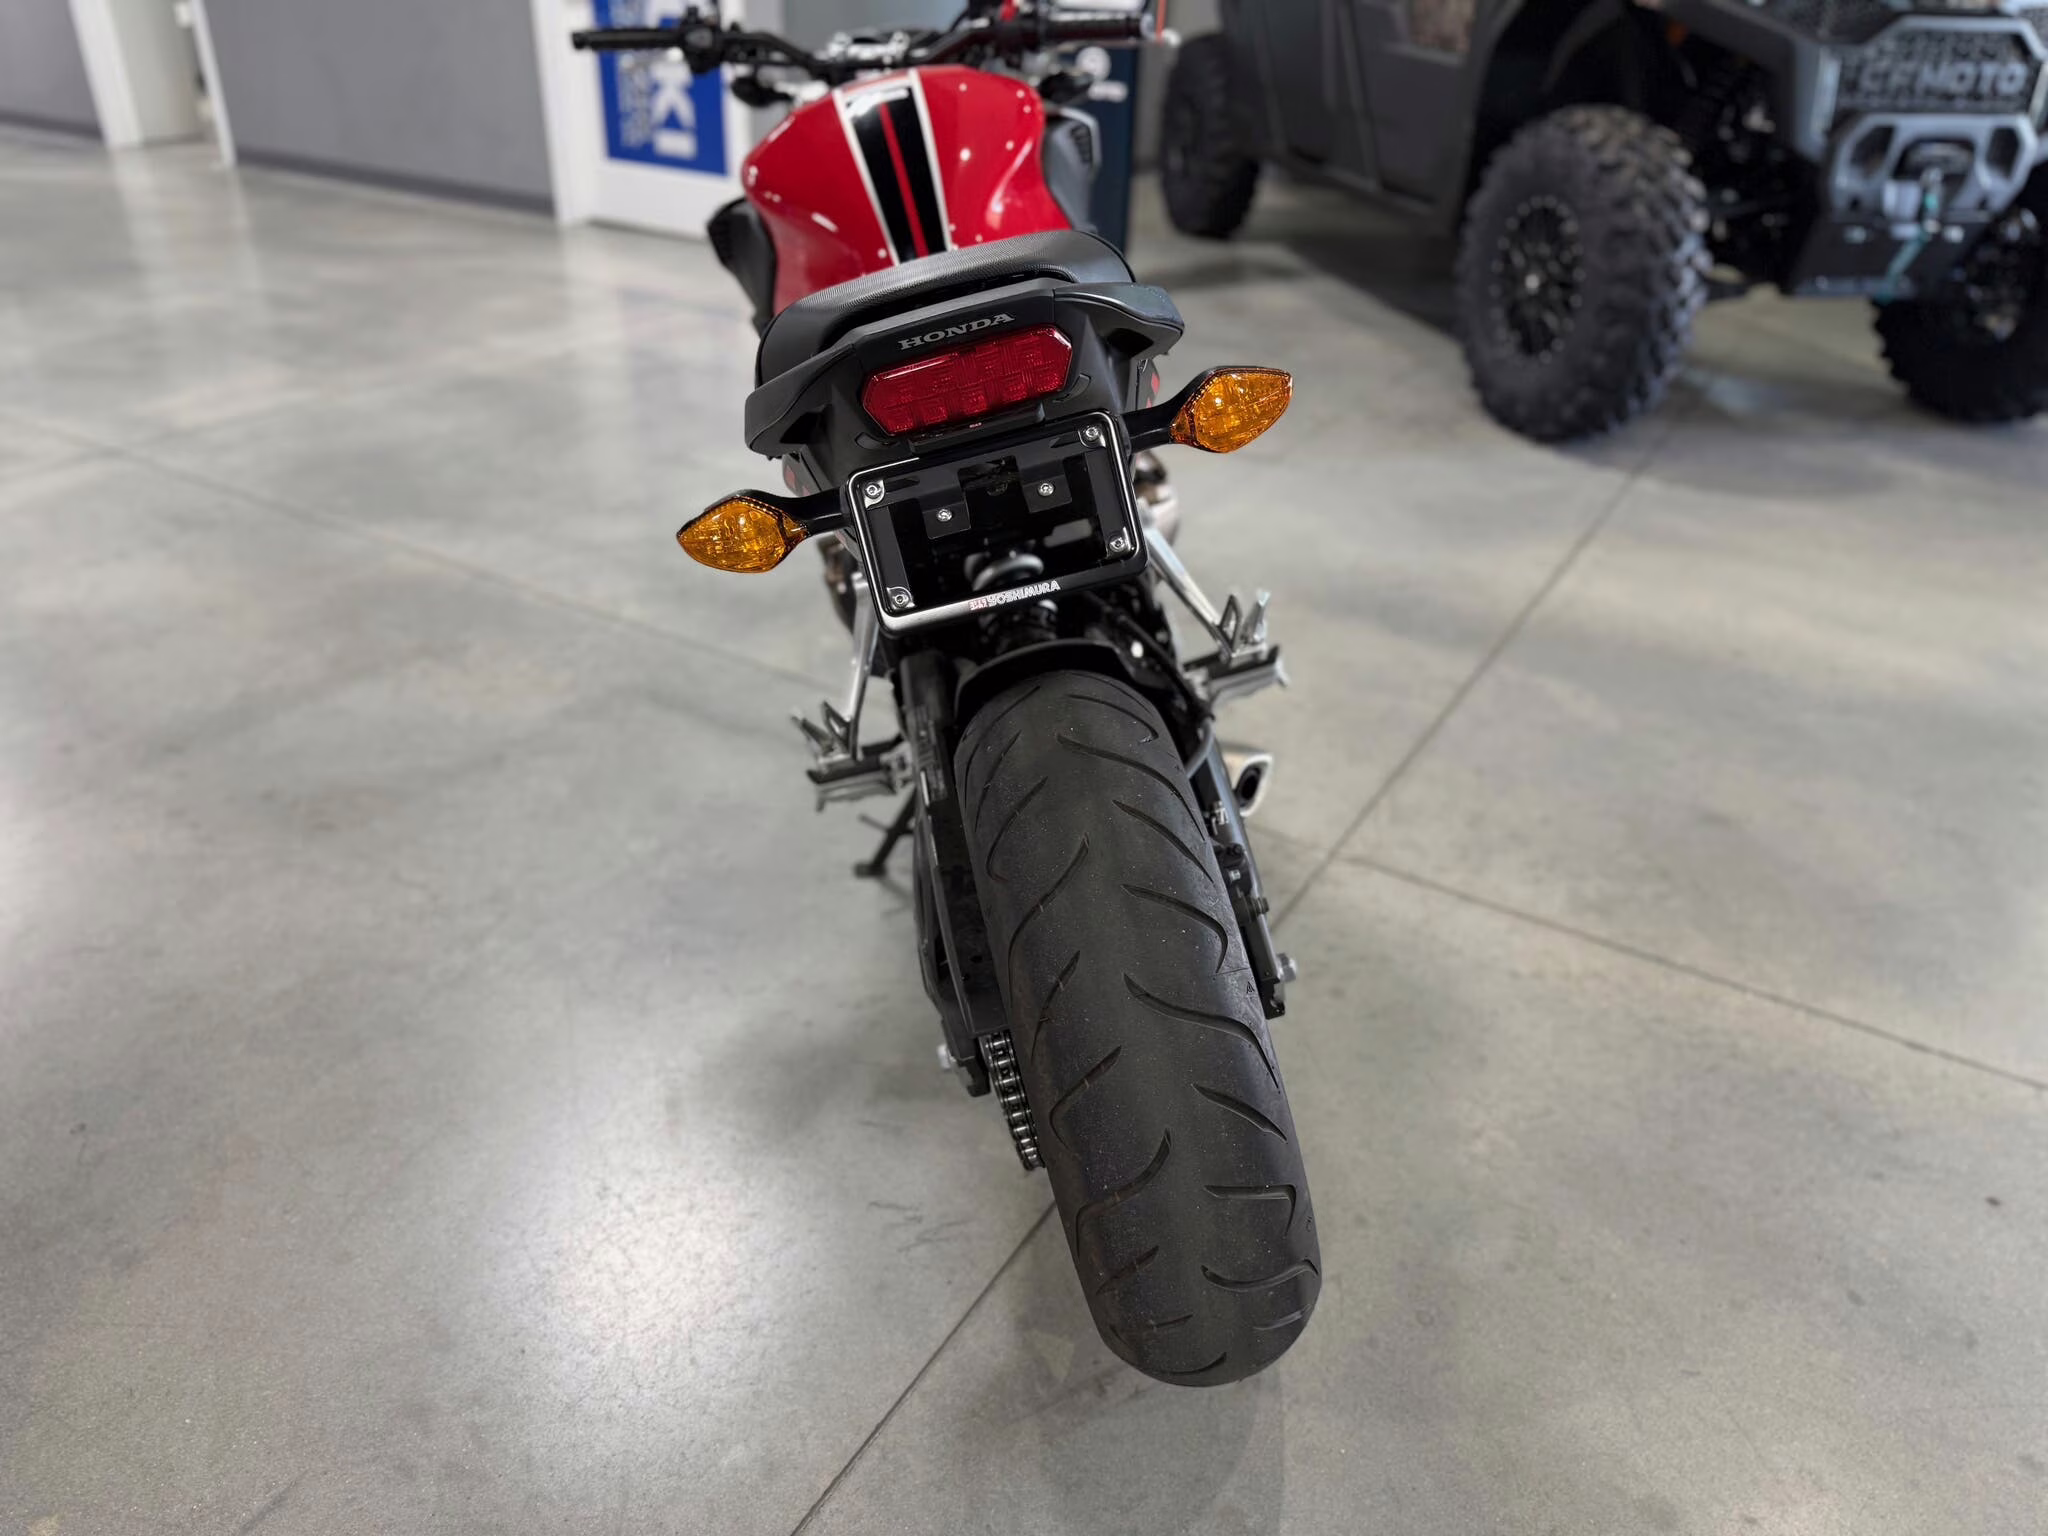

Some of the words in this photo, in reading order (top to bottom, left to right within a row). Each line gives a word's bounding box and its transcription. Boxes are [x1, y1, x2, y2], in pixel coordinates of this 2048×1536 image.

[1859, 60, 2028, 96] CFMOTO
[898, 313, 1015, 350] HONDA
[986, 580, 1061, 608] YOSHIMURA
